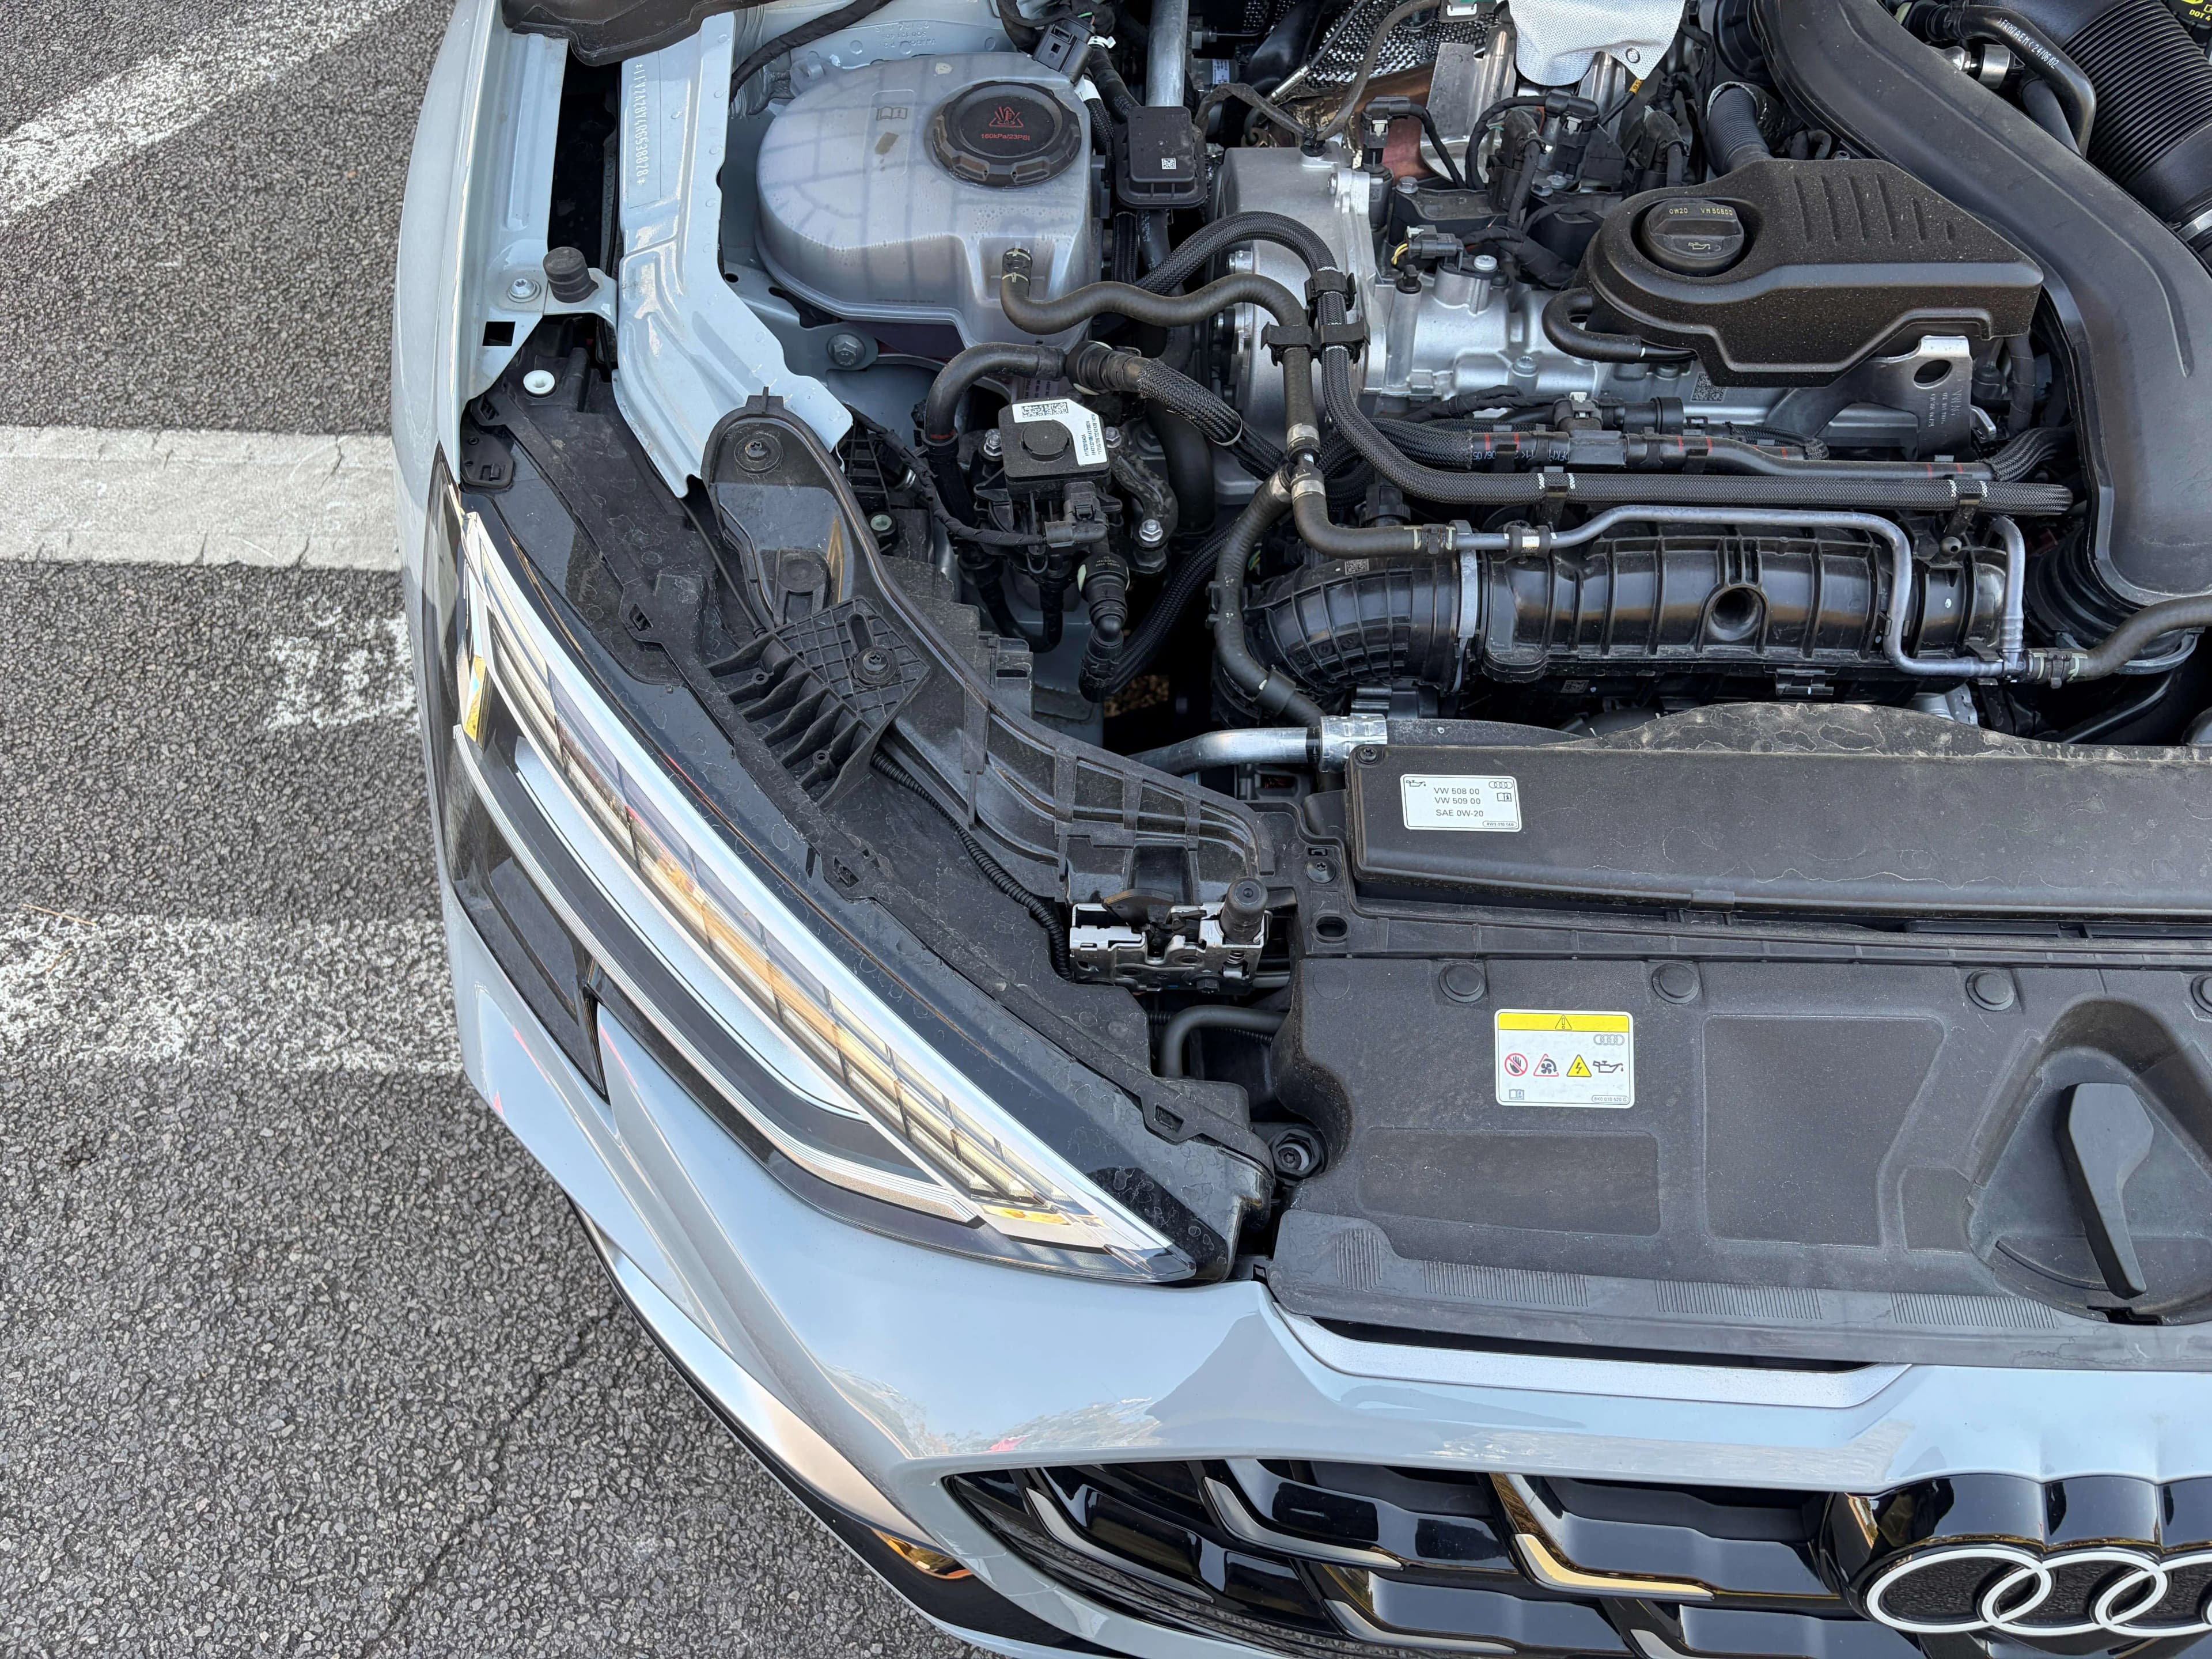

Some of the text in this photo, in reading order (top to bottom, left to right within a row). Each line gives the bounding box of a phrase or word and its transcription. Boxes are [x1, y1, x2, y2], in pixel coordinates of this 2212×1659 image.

[2189, 9, 2205, 18] DOT
[981, 133, 1030, 141] 160kPa/23PSI
[1457, 809, 1484, 817] 0W-20
